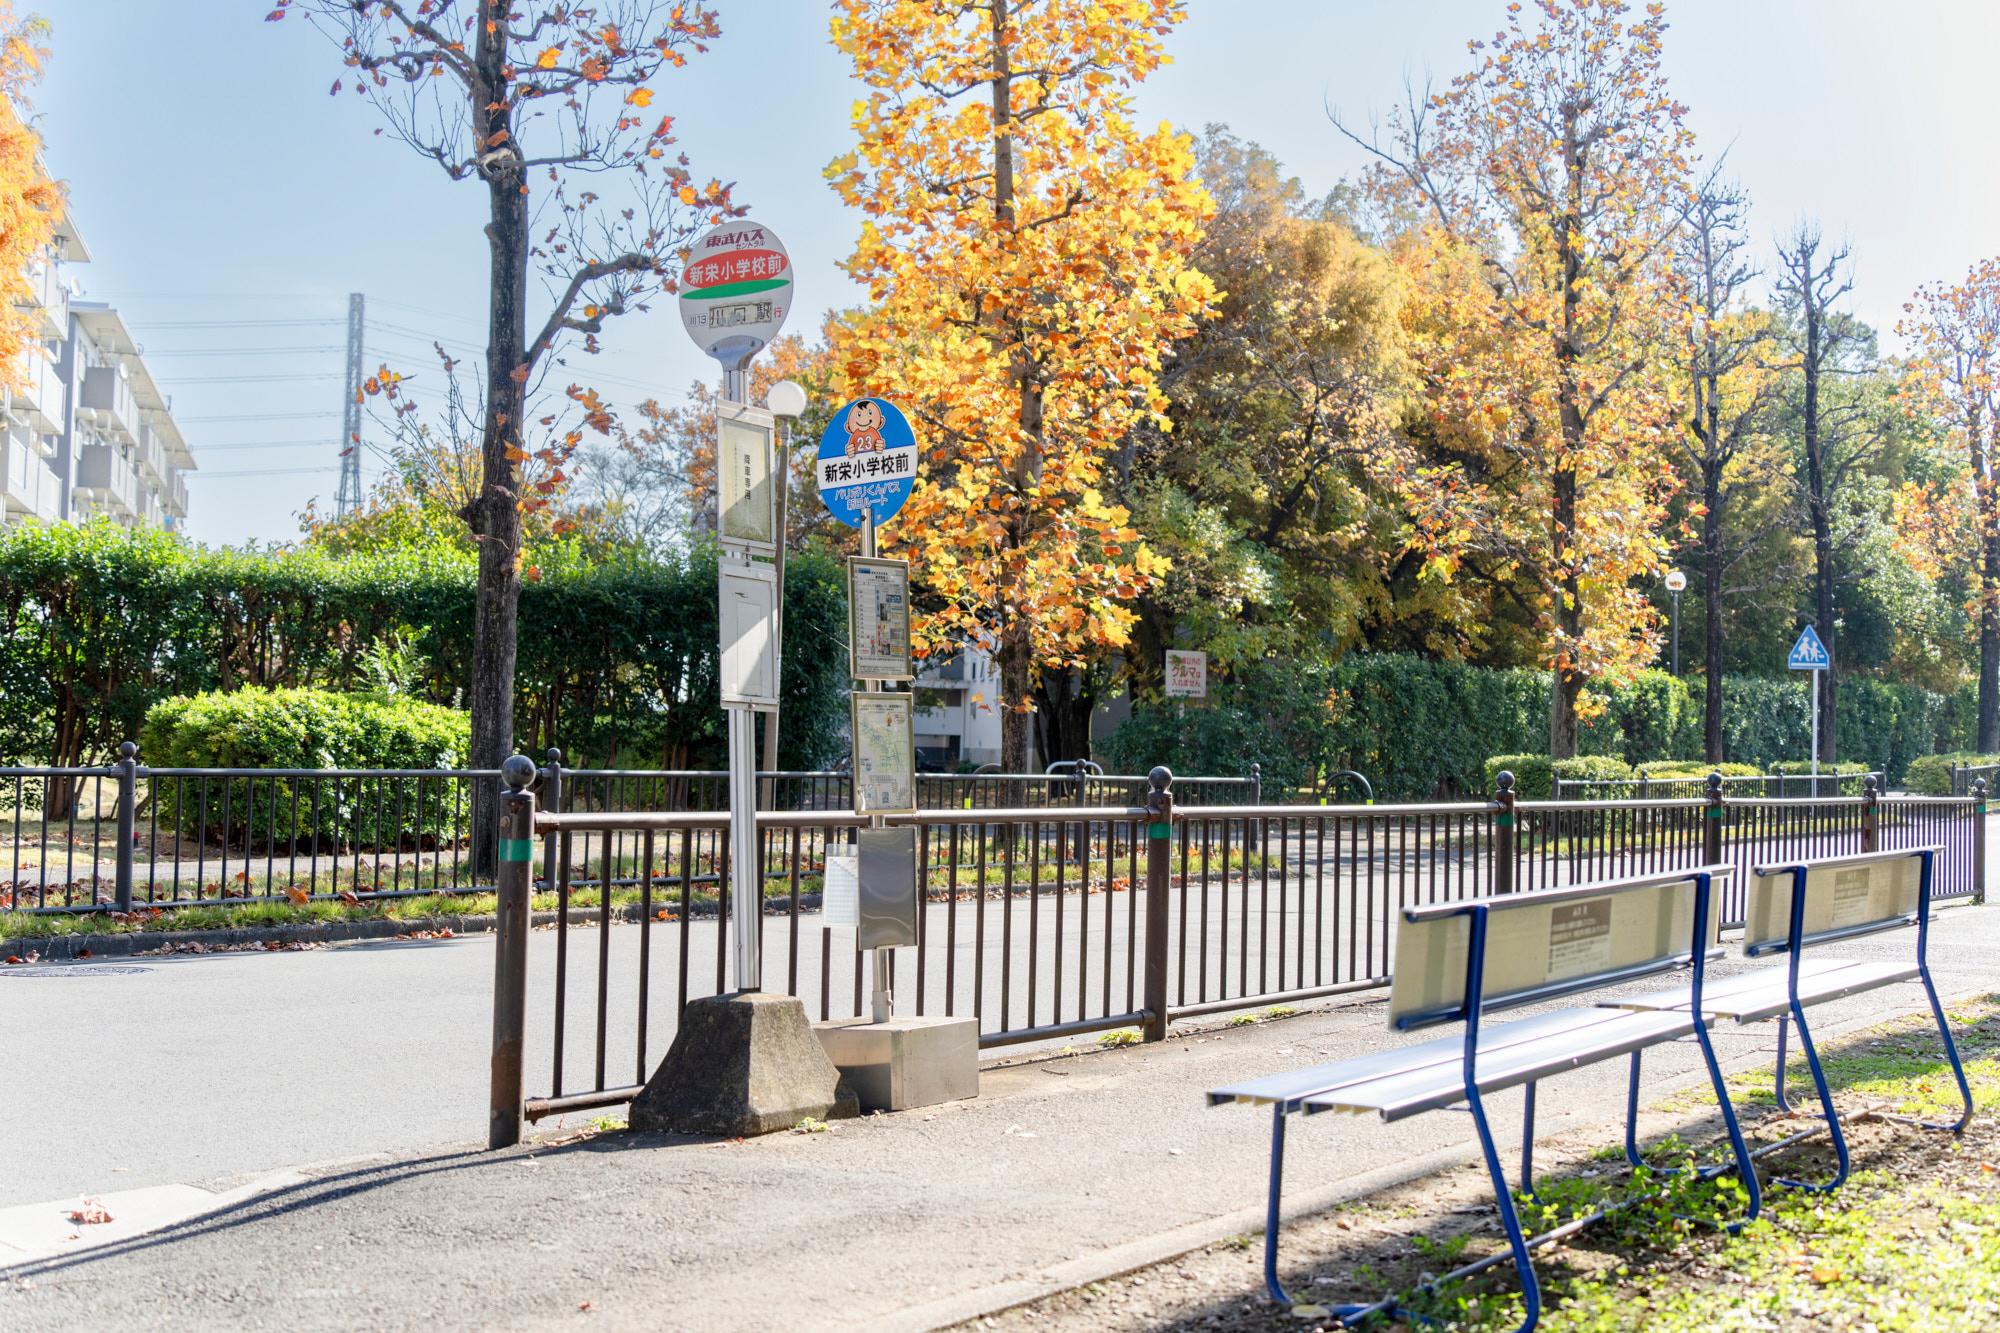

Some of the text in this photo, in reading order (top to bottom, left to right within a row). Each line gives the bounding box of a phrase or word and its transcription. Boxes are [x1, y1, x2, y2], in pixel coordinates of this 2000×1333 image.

[705, 228, 765, 248] 東武バス
[689, 255, 782, 285] 新栄小学校前
[857, 435, 873, 452] 23
[825, 453, 909, 483] 新栄小学校前
